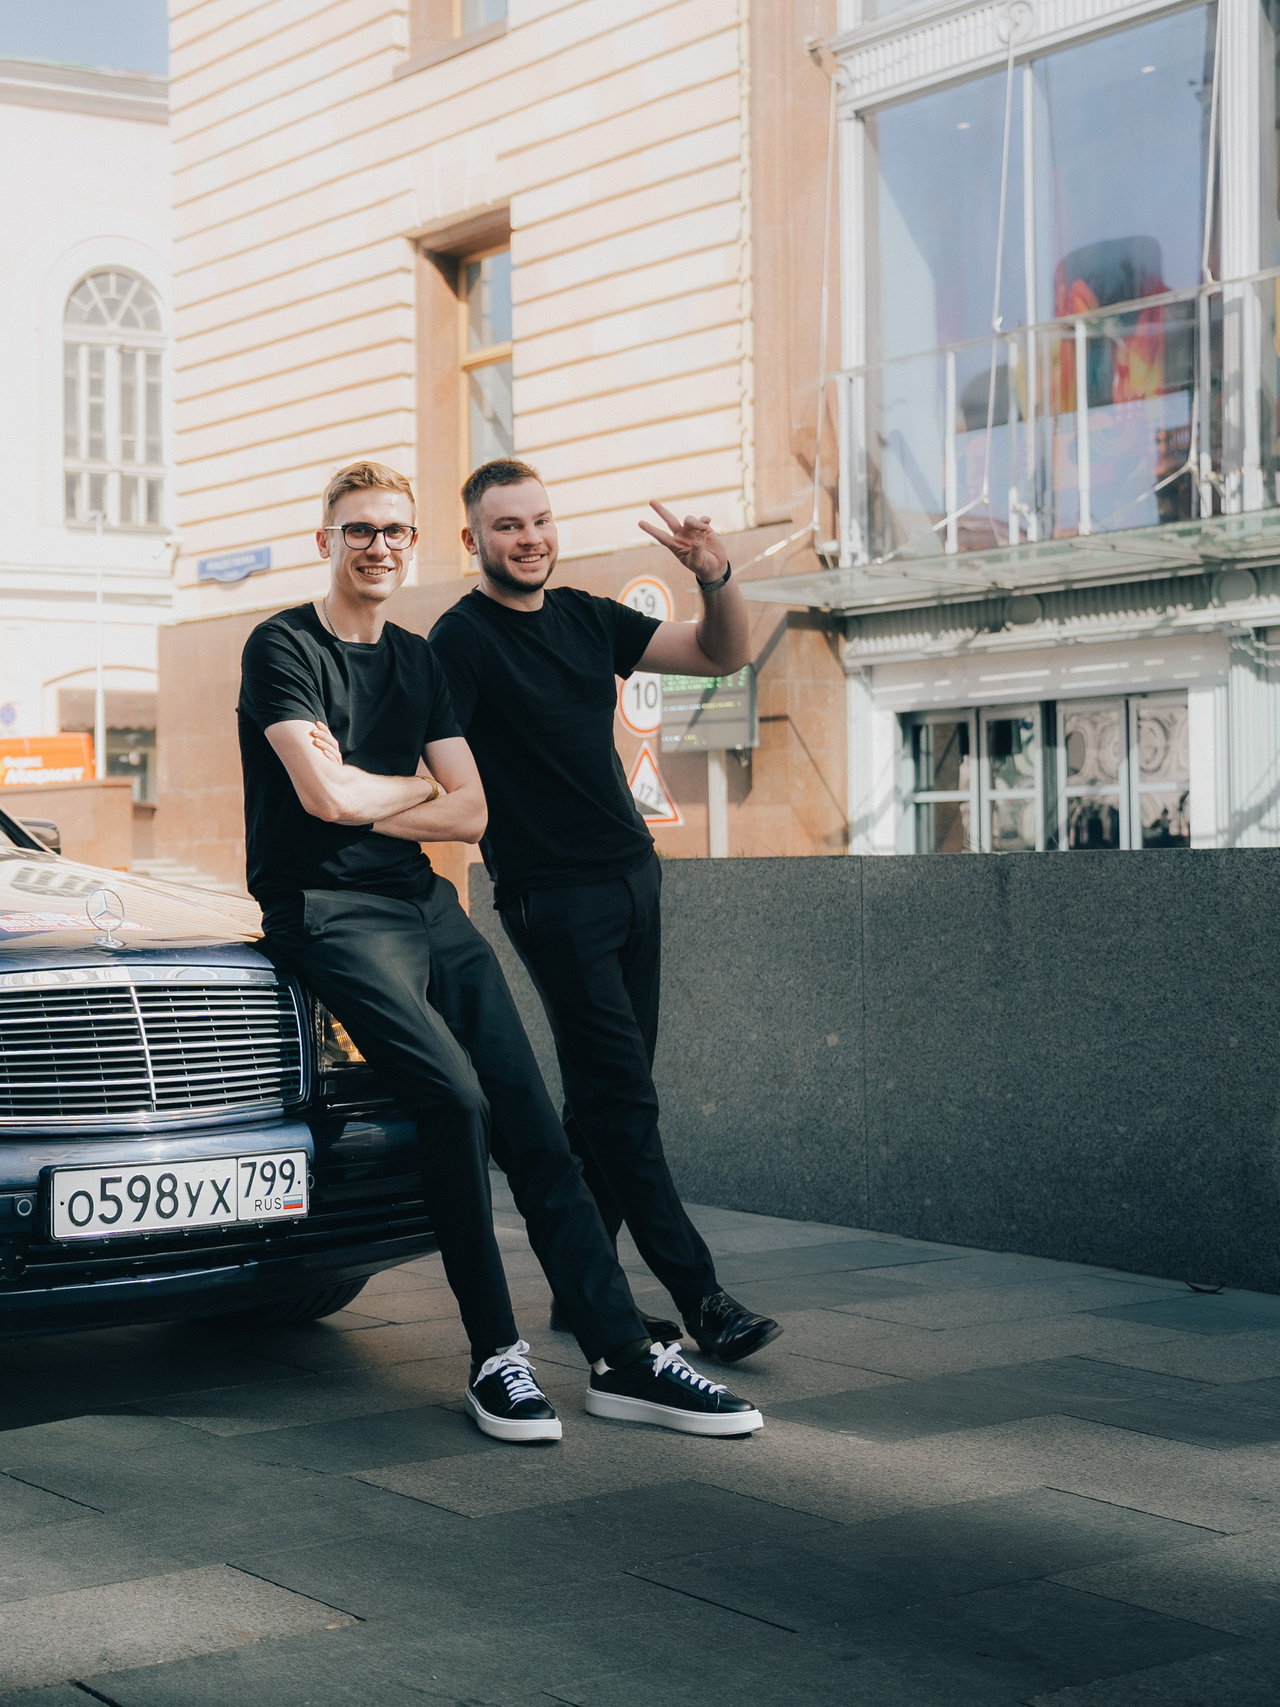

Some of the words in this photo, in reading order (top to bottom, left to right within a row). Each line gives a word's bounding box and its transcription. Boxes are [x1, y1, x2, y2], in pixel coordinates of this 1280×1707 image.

[632, 680, 658, 710] 10
[240, 1158, 296, 1199] 799
[254, 1197, 283, 1213] RUS
